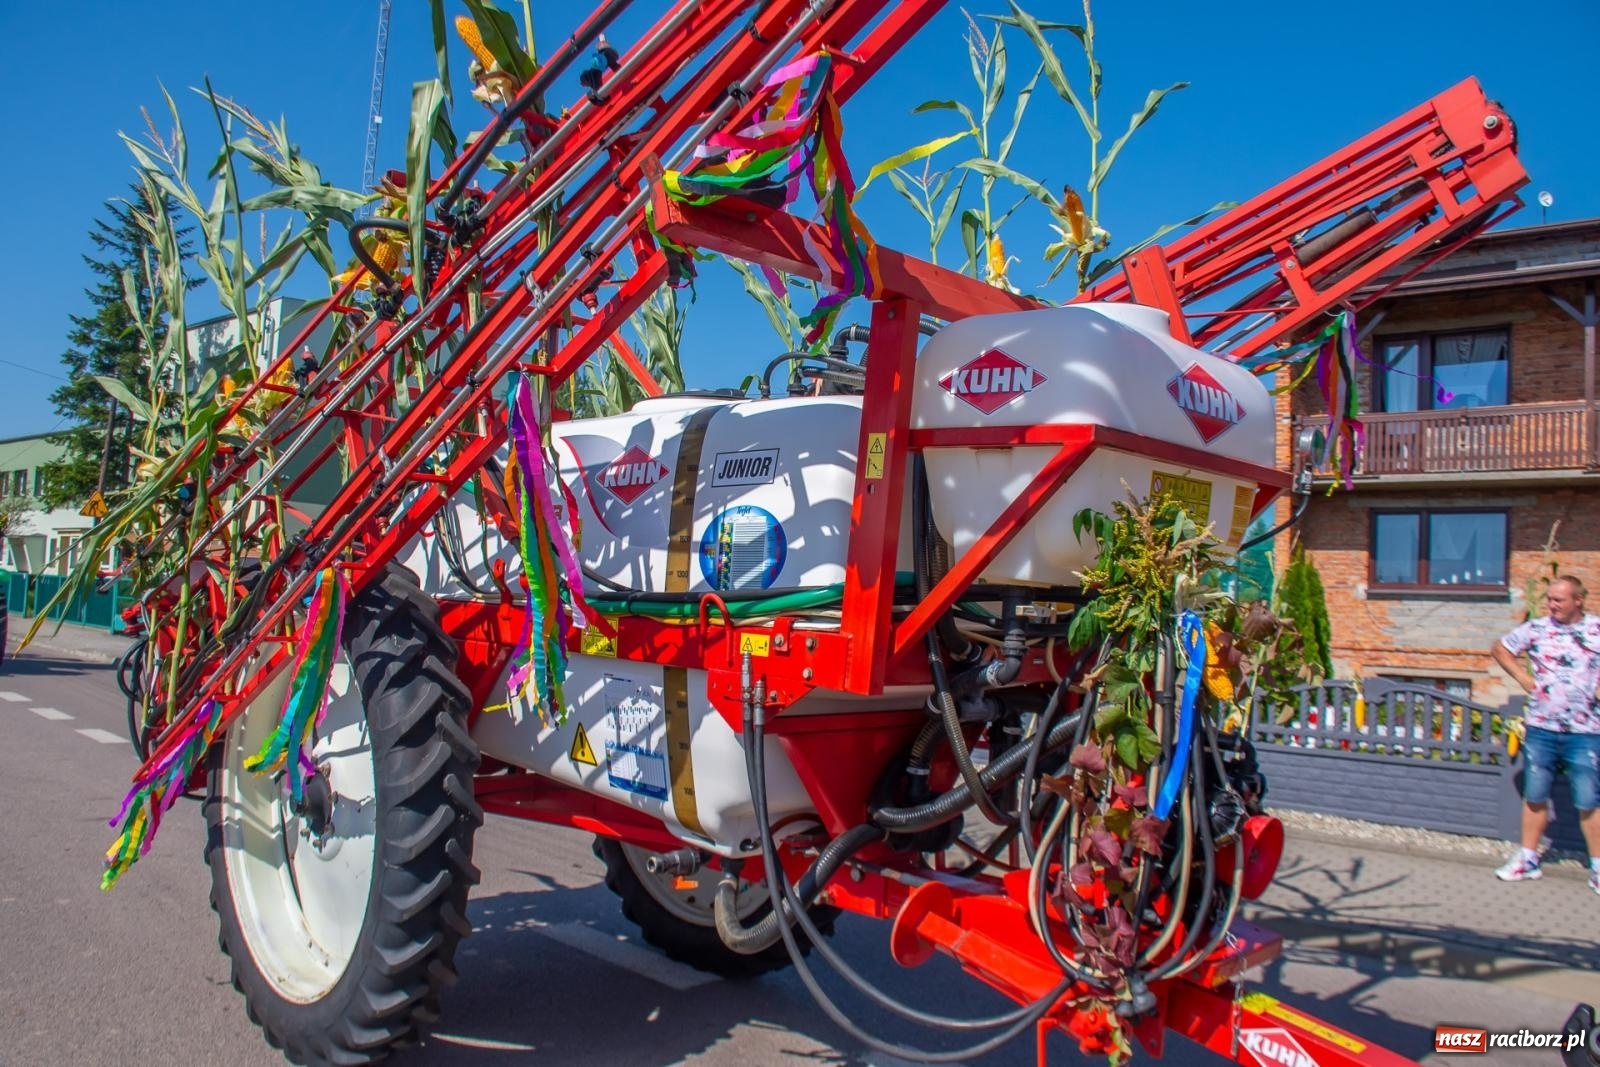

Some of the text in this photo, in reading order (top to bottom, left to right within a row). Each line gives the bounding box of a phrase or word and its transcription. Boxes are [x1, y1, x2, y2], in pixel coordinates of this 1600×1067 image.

[951, 366, 1033, 395] KUHN
[1177, 375, 1240, 424] KUHN
[604, 459, 661, 487] KUHN
[718, 457, 772, 479] JUNIOR
